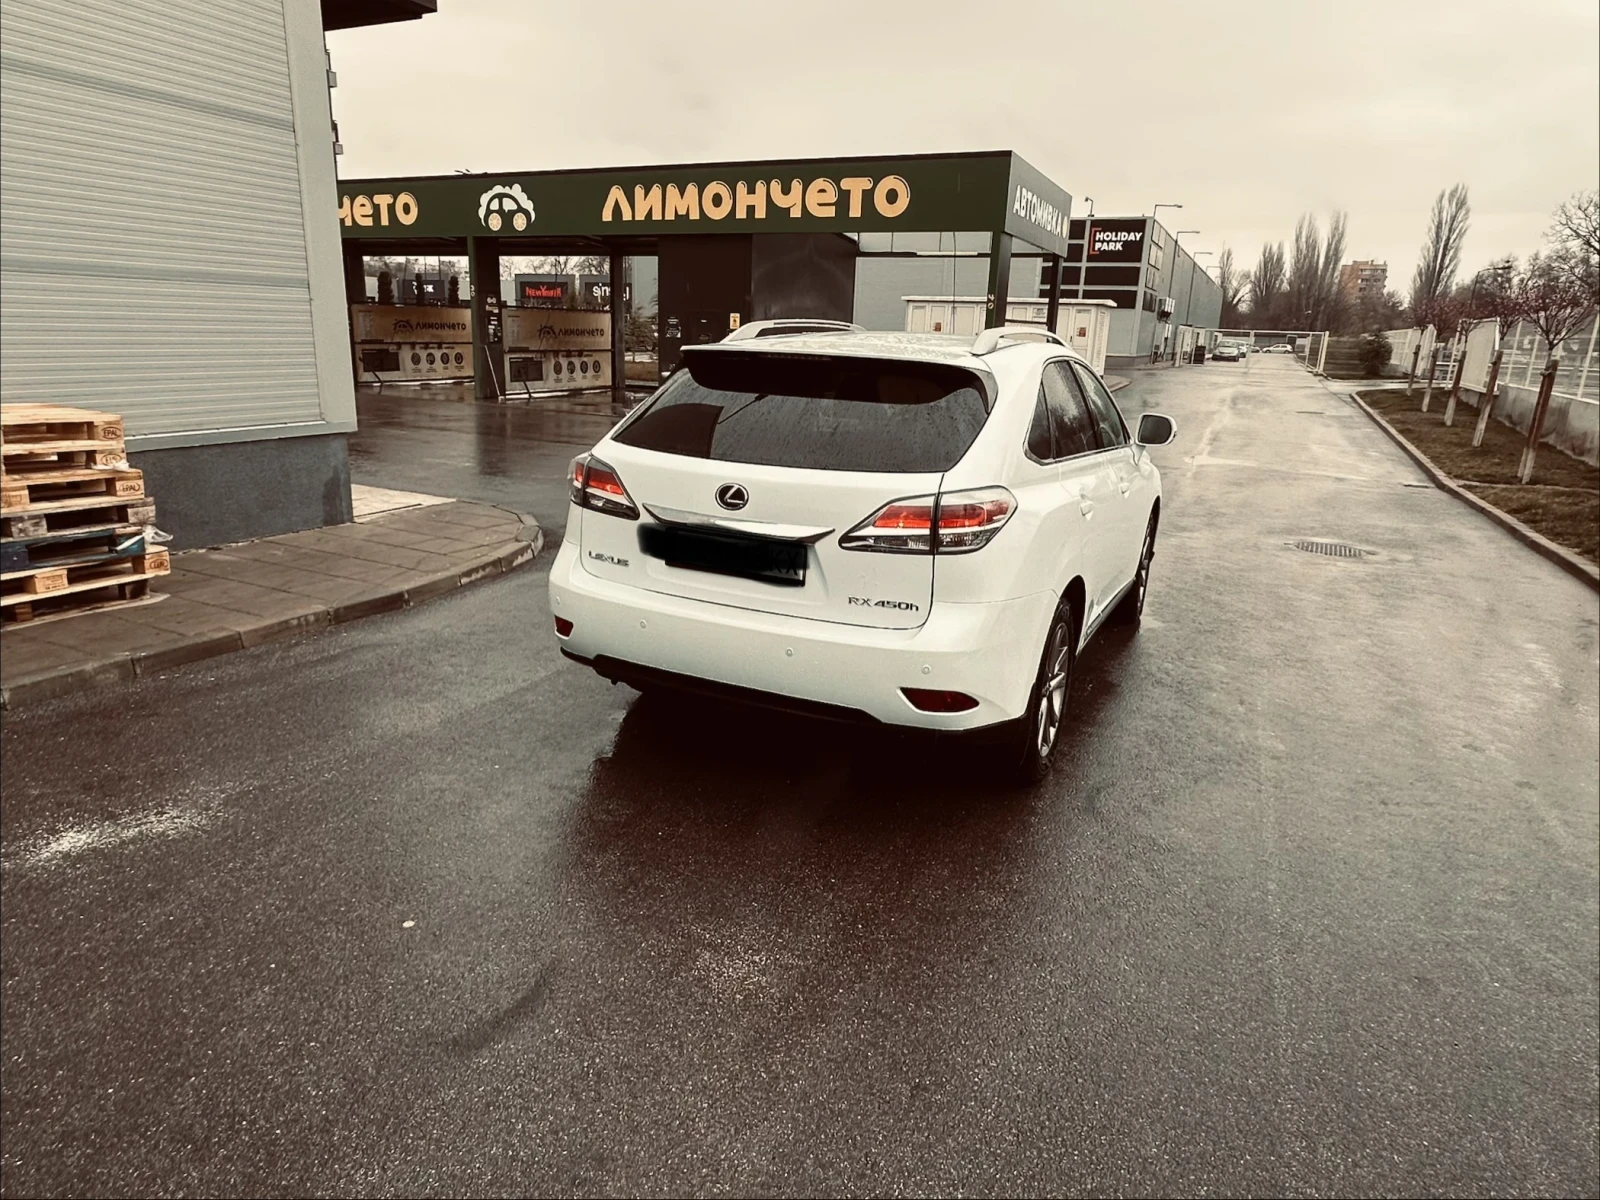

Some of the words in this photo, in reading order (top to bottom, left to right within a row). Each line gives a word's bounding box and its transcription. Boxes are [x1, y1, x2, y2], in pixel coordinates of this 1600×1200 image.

[1013, 184, 1062, 237] АВТОМИВКА
[1095, 231, 1143, 241] HOLIDAY
[1094, 242, 1123, 251] PARK
[588, 550, 630, 567] LEXUS
